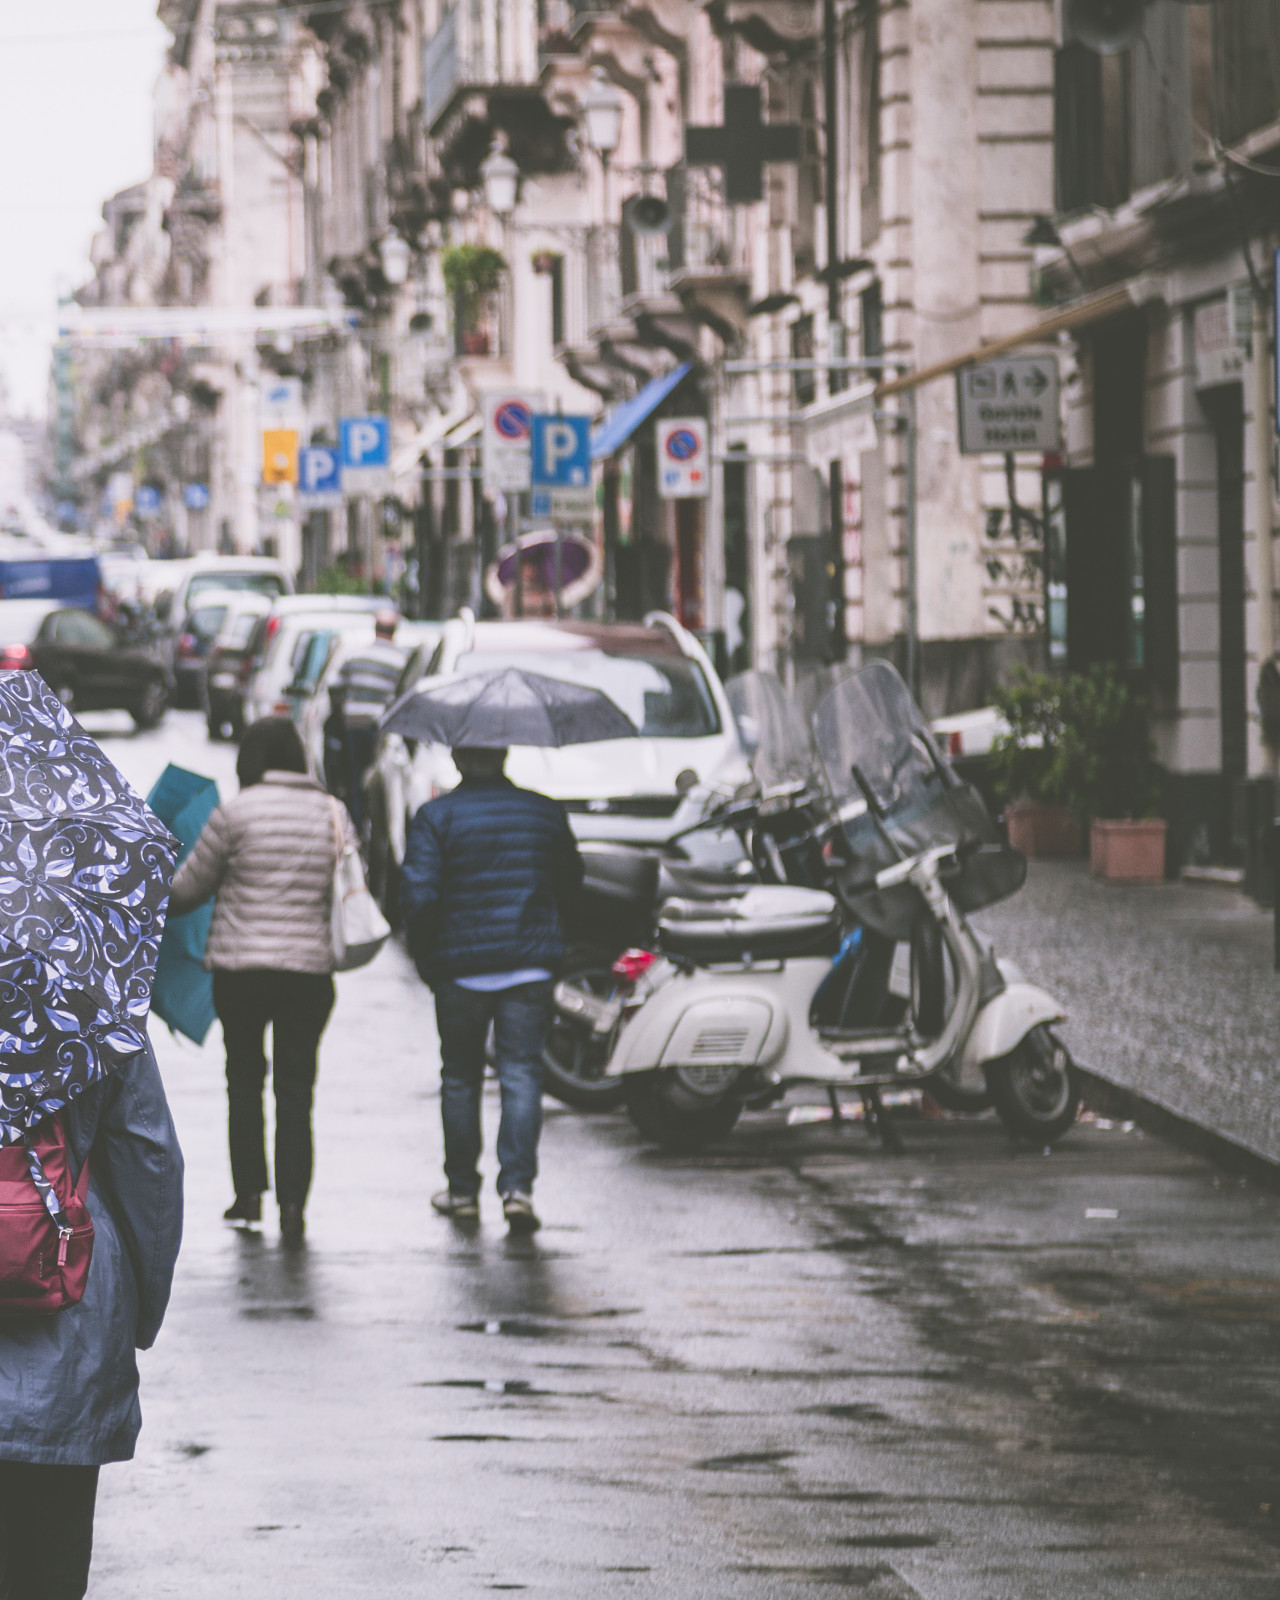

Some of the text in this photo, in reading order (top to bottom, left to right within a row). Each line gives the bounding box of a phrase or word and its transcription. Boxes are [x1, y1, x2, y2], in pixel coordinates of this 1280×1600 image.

[349, 423, 379, 462] P
[544, 423, 577, 476] P
[305, 449, 334, 488] P
